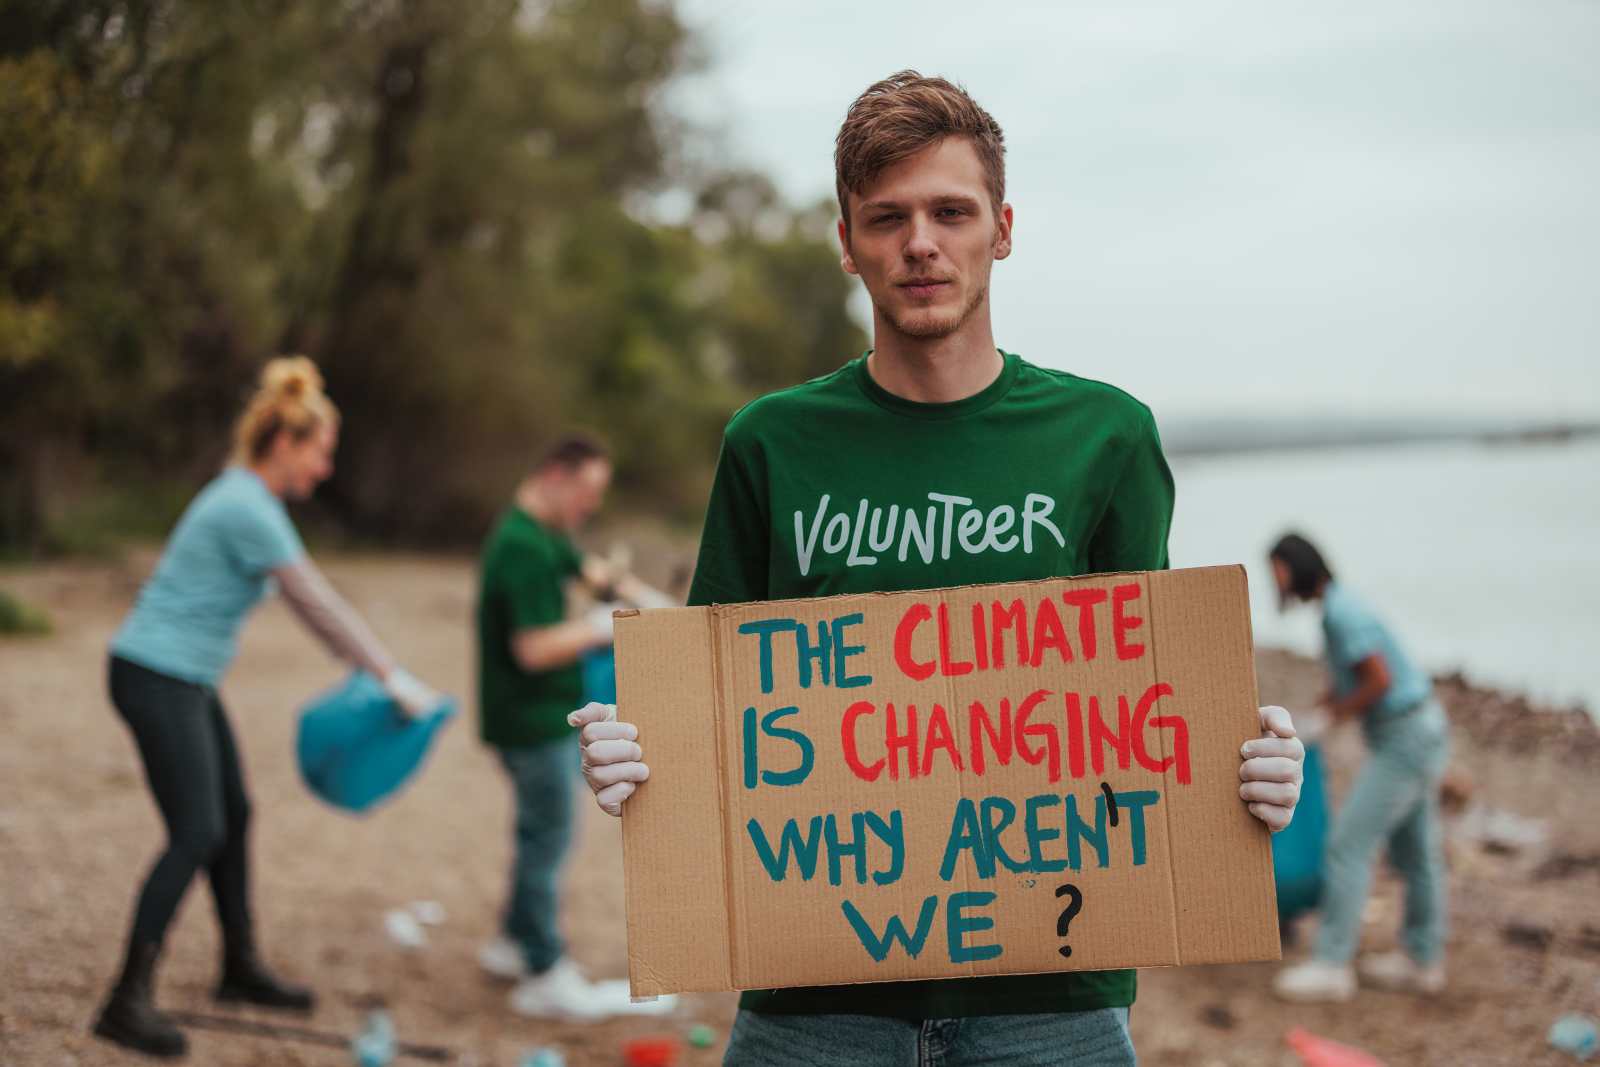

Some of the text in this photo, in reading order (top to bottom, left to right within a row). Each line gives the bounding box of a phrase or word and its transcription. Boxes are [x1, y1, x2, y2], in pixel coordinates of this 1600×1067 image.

[738, 584, 1145, 693] THE CLIMATE
[742, 683, 1192, 788] IS CHANGING
[747, 782, 1160, 886] WHY AREN'T
[841, 884, 1083, 963] WE ?
